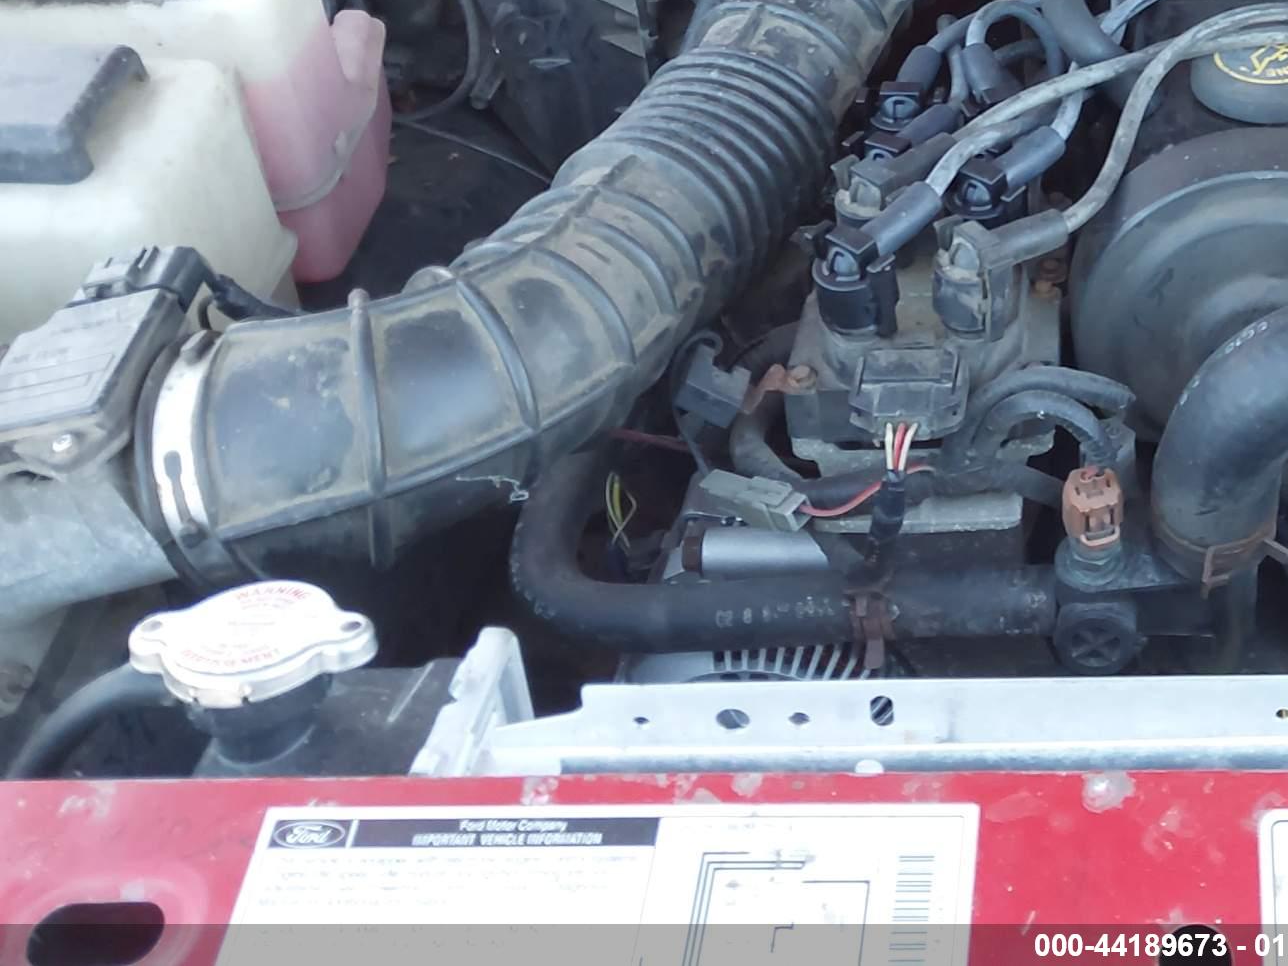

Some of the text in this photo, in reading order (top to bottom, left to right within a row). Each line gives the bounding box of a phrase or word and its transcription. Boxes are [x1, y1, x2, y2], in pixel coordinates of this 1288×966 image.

[459, 819, 567, 833] Ford Motor Company
[286, 825, 331, 845] Ford
[412, 832, 602, 846] IMPORTANT VEHICLE INFORMATION
